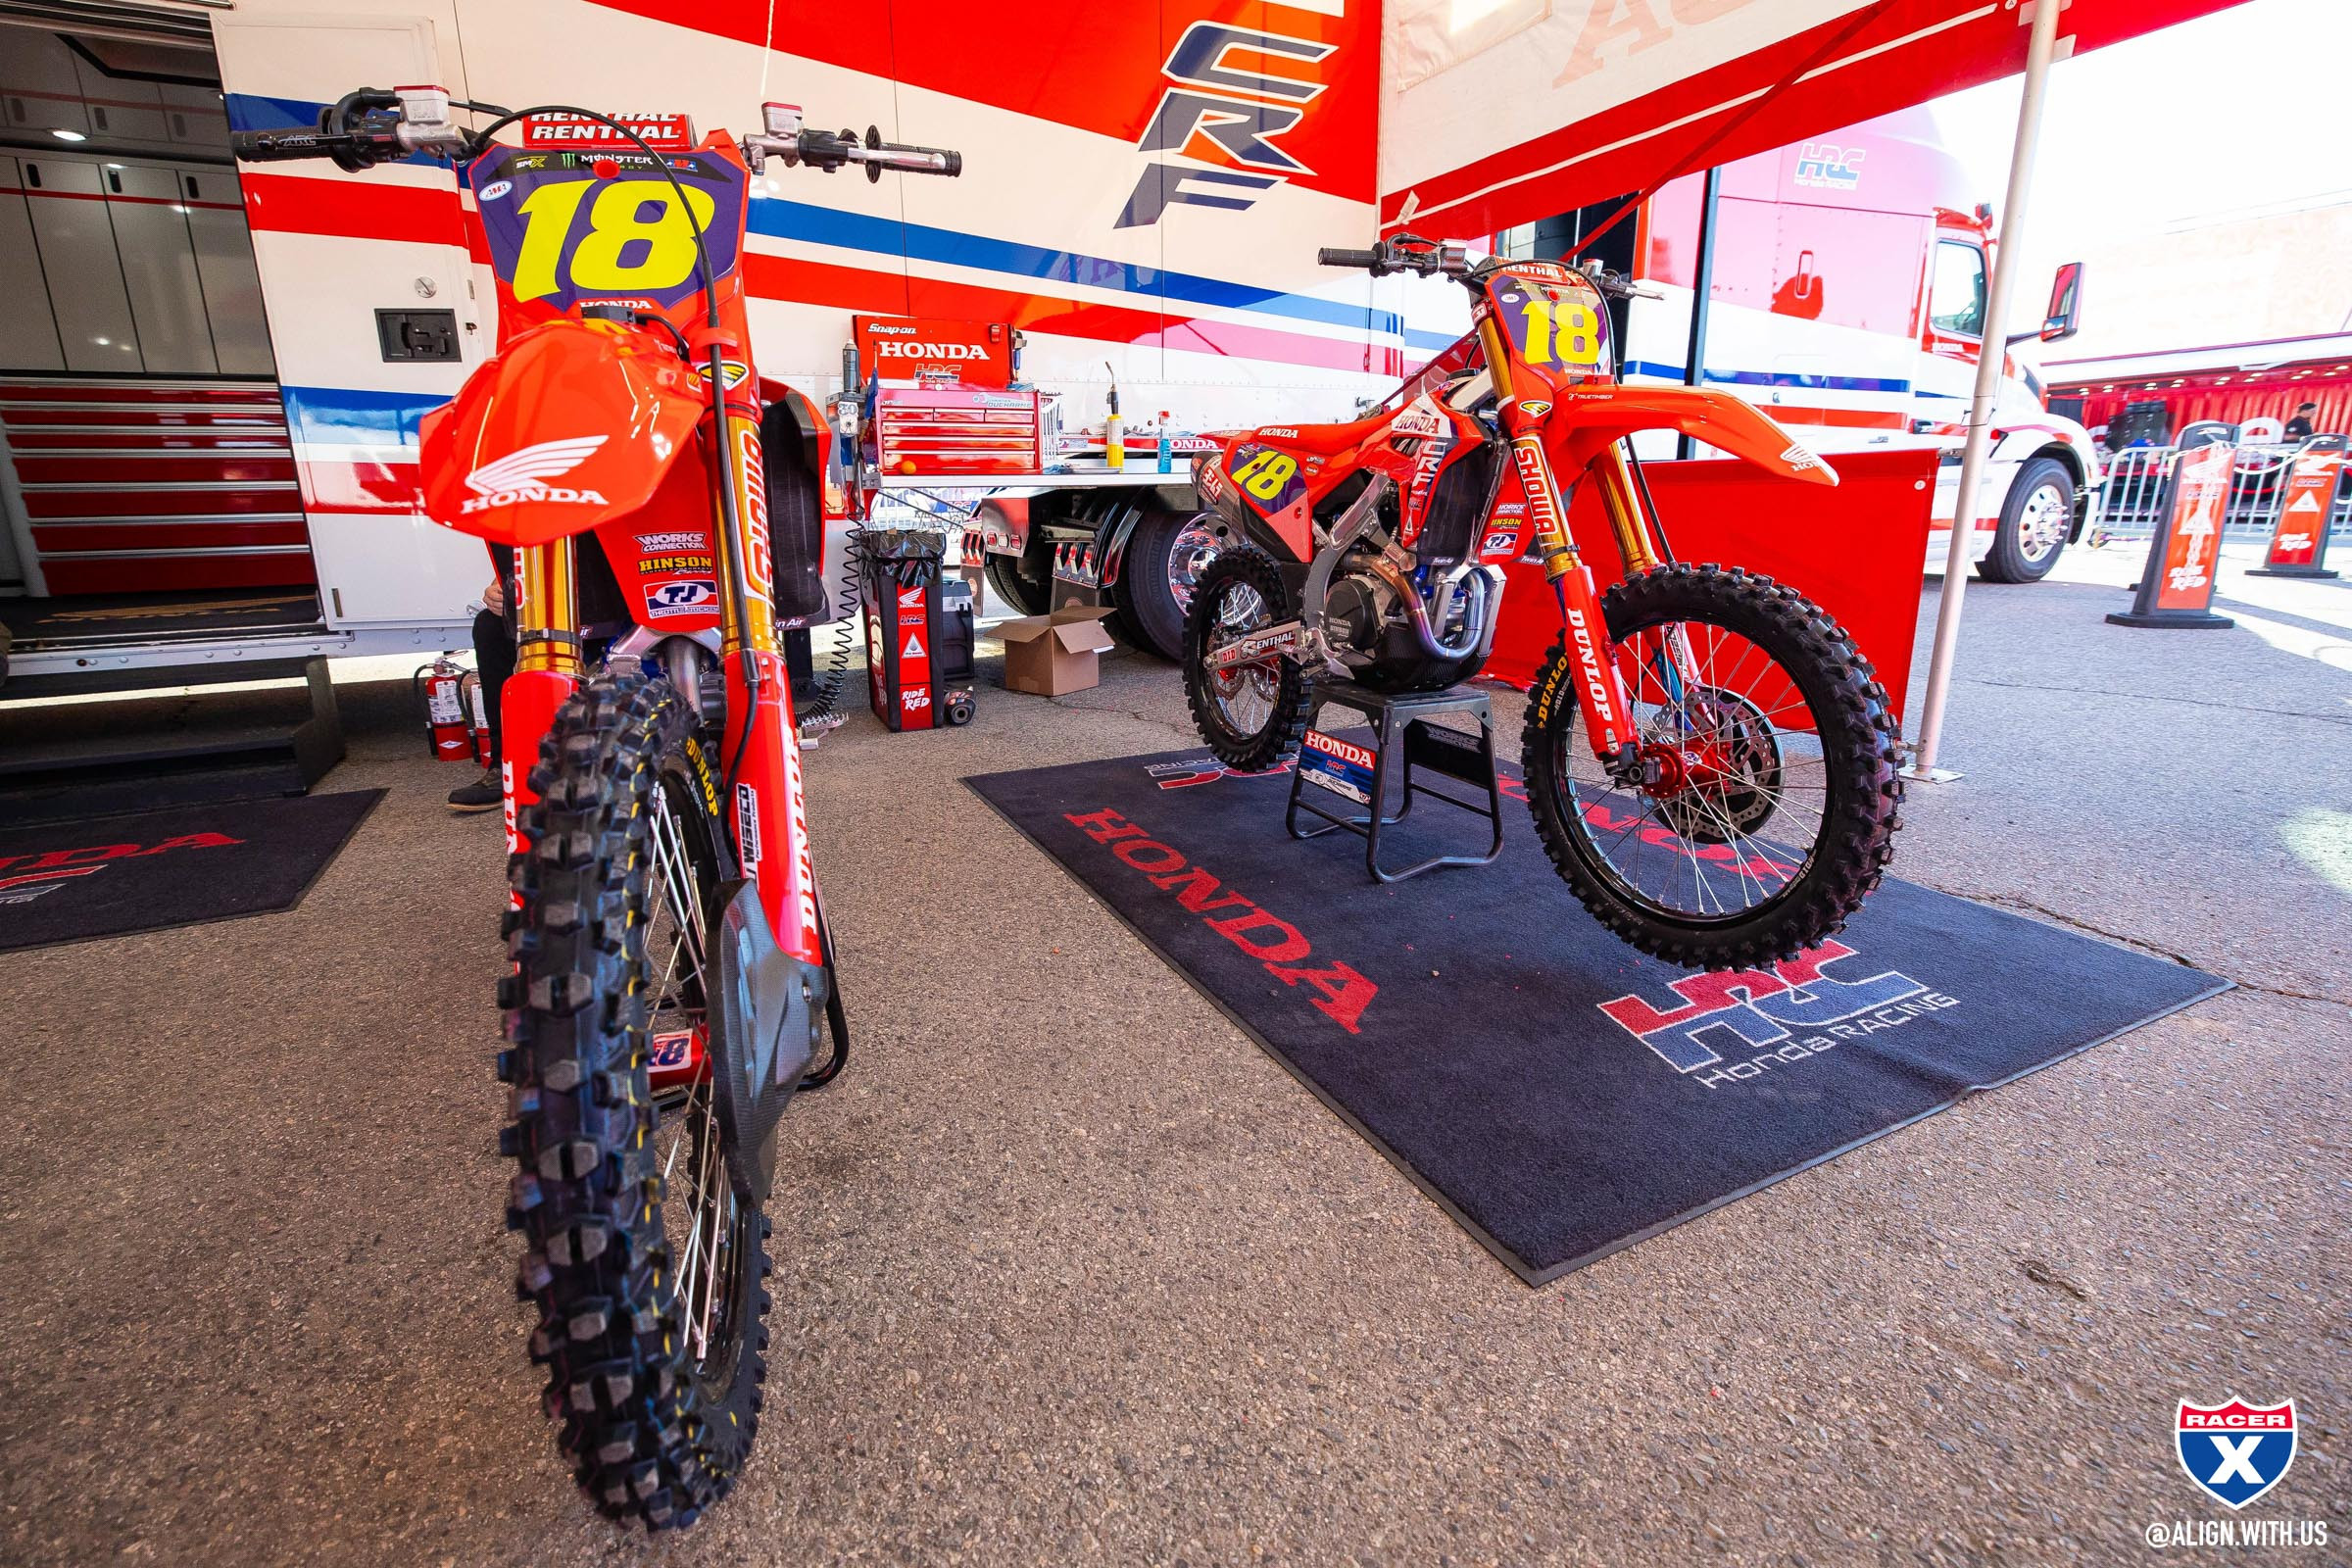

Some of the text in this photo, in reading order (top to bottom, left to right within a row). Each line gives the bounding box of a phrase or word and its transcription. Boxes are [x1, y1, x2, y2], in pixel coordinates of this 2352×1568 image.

[532, 125, 681, 139] RENTHAL
[1113, 20, 1340, 228] CRF
[513, 179, 715, 303] 18
[879, 341, 991, 360] HONDA
[1521, 301, 1599, 365] 18
[1156, 439, 1219, 449] ONDA
[1258, 428, 1299, 438] HONDA
[1396, 416, 1441, 434] HONDA
[1231, 450, 1298, 501] 18
[1412, 441, 1448, 487] CRF
[462, 487, 609, 514] HONDA
[1514, 447, 1558, 536] SHOWA
[636, 533, 705, 545] WORKS
[643, 542, 706, 553] CONNECTION
[638, 557, 712, 571] HINSON
[664, 585, 699, 604] TJ
[1567, 609, 1613, 722] DUNLOP
[903, 688, 926, 700] RIDE
[905, 697, 930, 710] RED
[1539, 652, 1568, 722] DUNLO
[1305, 731, 1374, 769] HONDA
[687, 737, 718, 816] DUNLOP
[1063, 808, 1378, 1035] HONDA
[1596, 938, 1930, 1074] HRC
[1694, 990, 1960, 1090] Honda RACING
